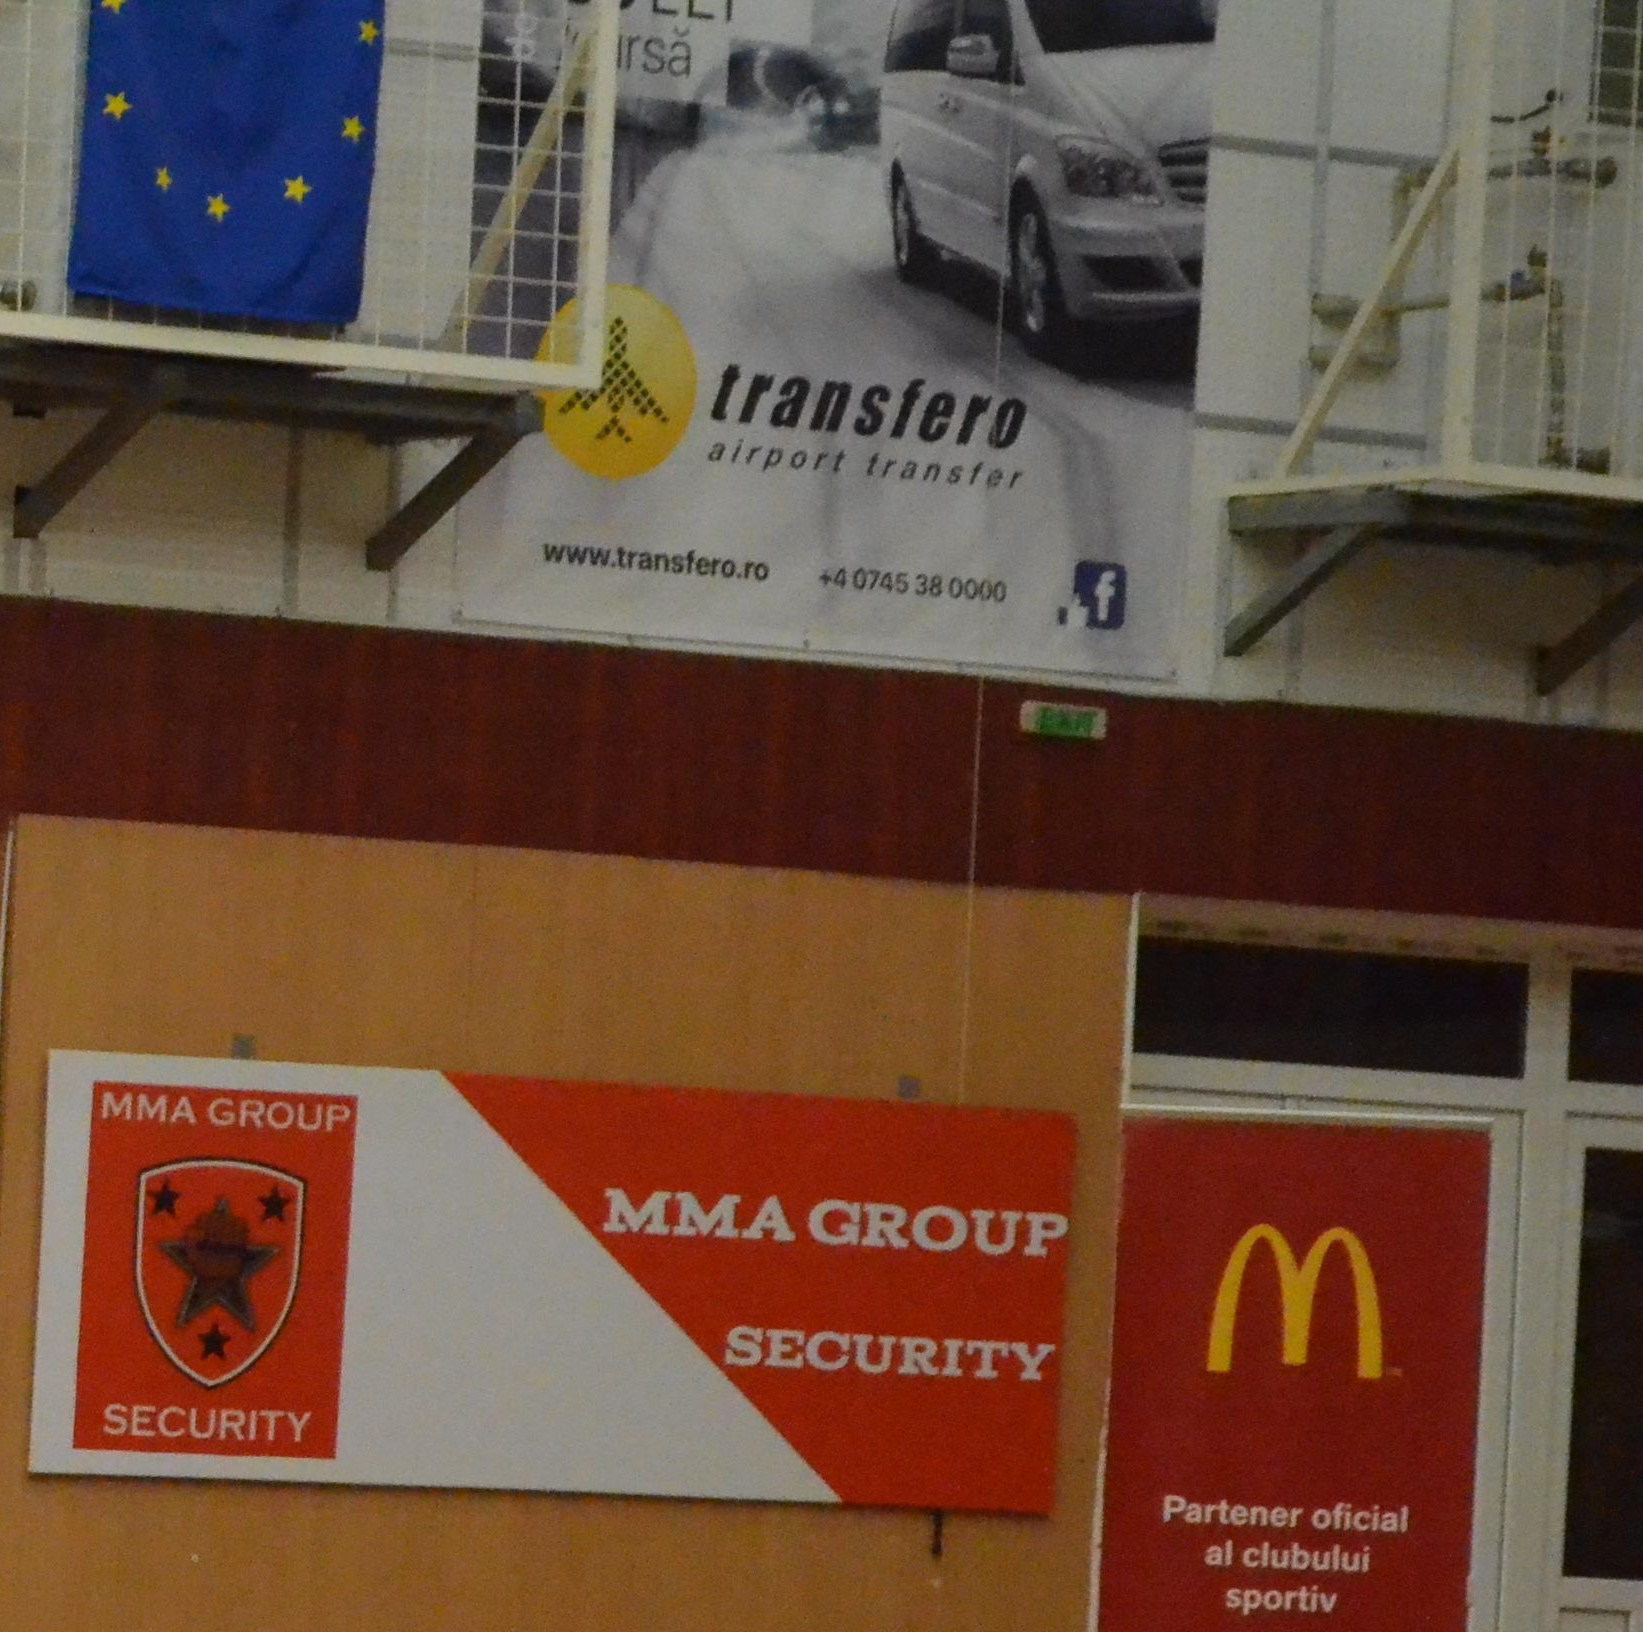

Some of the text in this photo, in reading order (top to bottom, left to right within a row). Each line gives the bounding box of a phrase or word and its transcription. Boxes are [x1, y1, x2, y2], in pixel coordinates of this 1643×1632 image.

[710, 363, 1028, 450] transfero
[708, 439, 1025, 489] airport transfer
[542, 542, 770, 582] www.transfero.ro
[852, 569, 910, 595] 0745
[915, 573, 944, 598] 38
[949, 577, 1008, 603] 0000
[100, 1091, 352, 1133] MMA GROUP
[603, 1187, 1070, 1259] MMA GROUP
[722, 1326, 1056, 1384] SECURITY
[101, 1403, 312, 1445] SECURITY
[1163, 1494, 1410, 1533] Partener oficial
[1204, 1539, 1370, 1573] al clubului
[1225, 1585, 1337, 1615] sportiv
